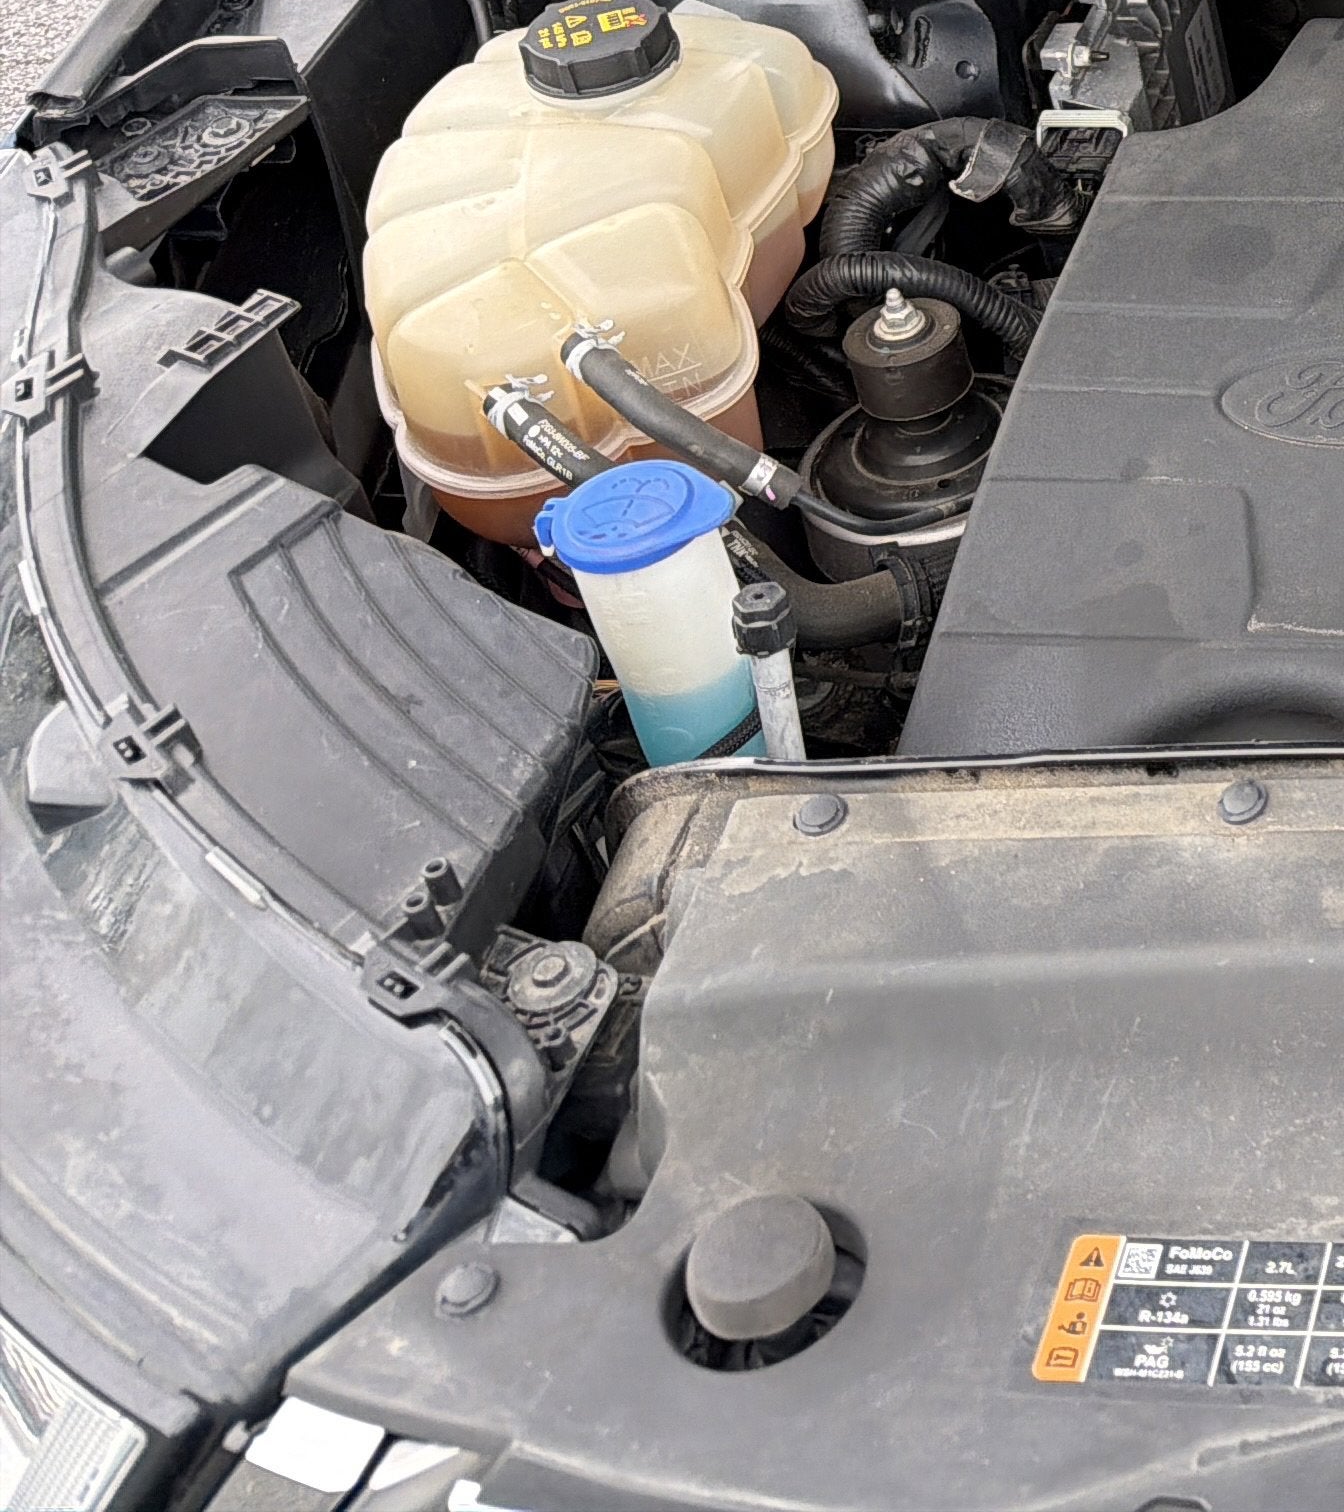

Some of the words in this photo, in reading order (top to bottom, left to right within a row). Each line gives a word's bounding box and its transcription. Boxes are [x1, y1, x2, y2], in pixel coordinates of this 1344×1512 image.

[640, 342, 697, 378] MAX
[1169, 1246, 1233, 1261] FoMoCo
[1265, 1261, 1296, 1275] 2.7L
[1247, 1290, 1282, 1303] 0.595
[1285, 1291, 1302, 1307] kg
[1256, 1304, 1270, 1315] 21
[1273, 1306, 1287, 1315] oz
[1138, 1309, 1189, 1325] R-134a
[1273, 1316, 1289, 1328] lbs
[1269, 1348, 1286, 1359] oz
[1134, 1354, 1170, 1368] PAG
